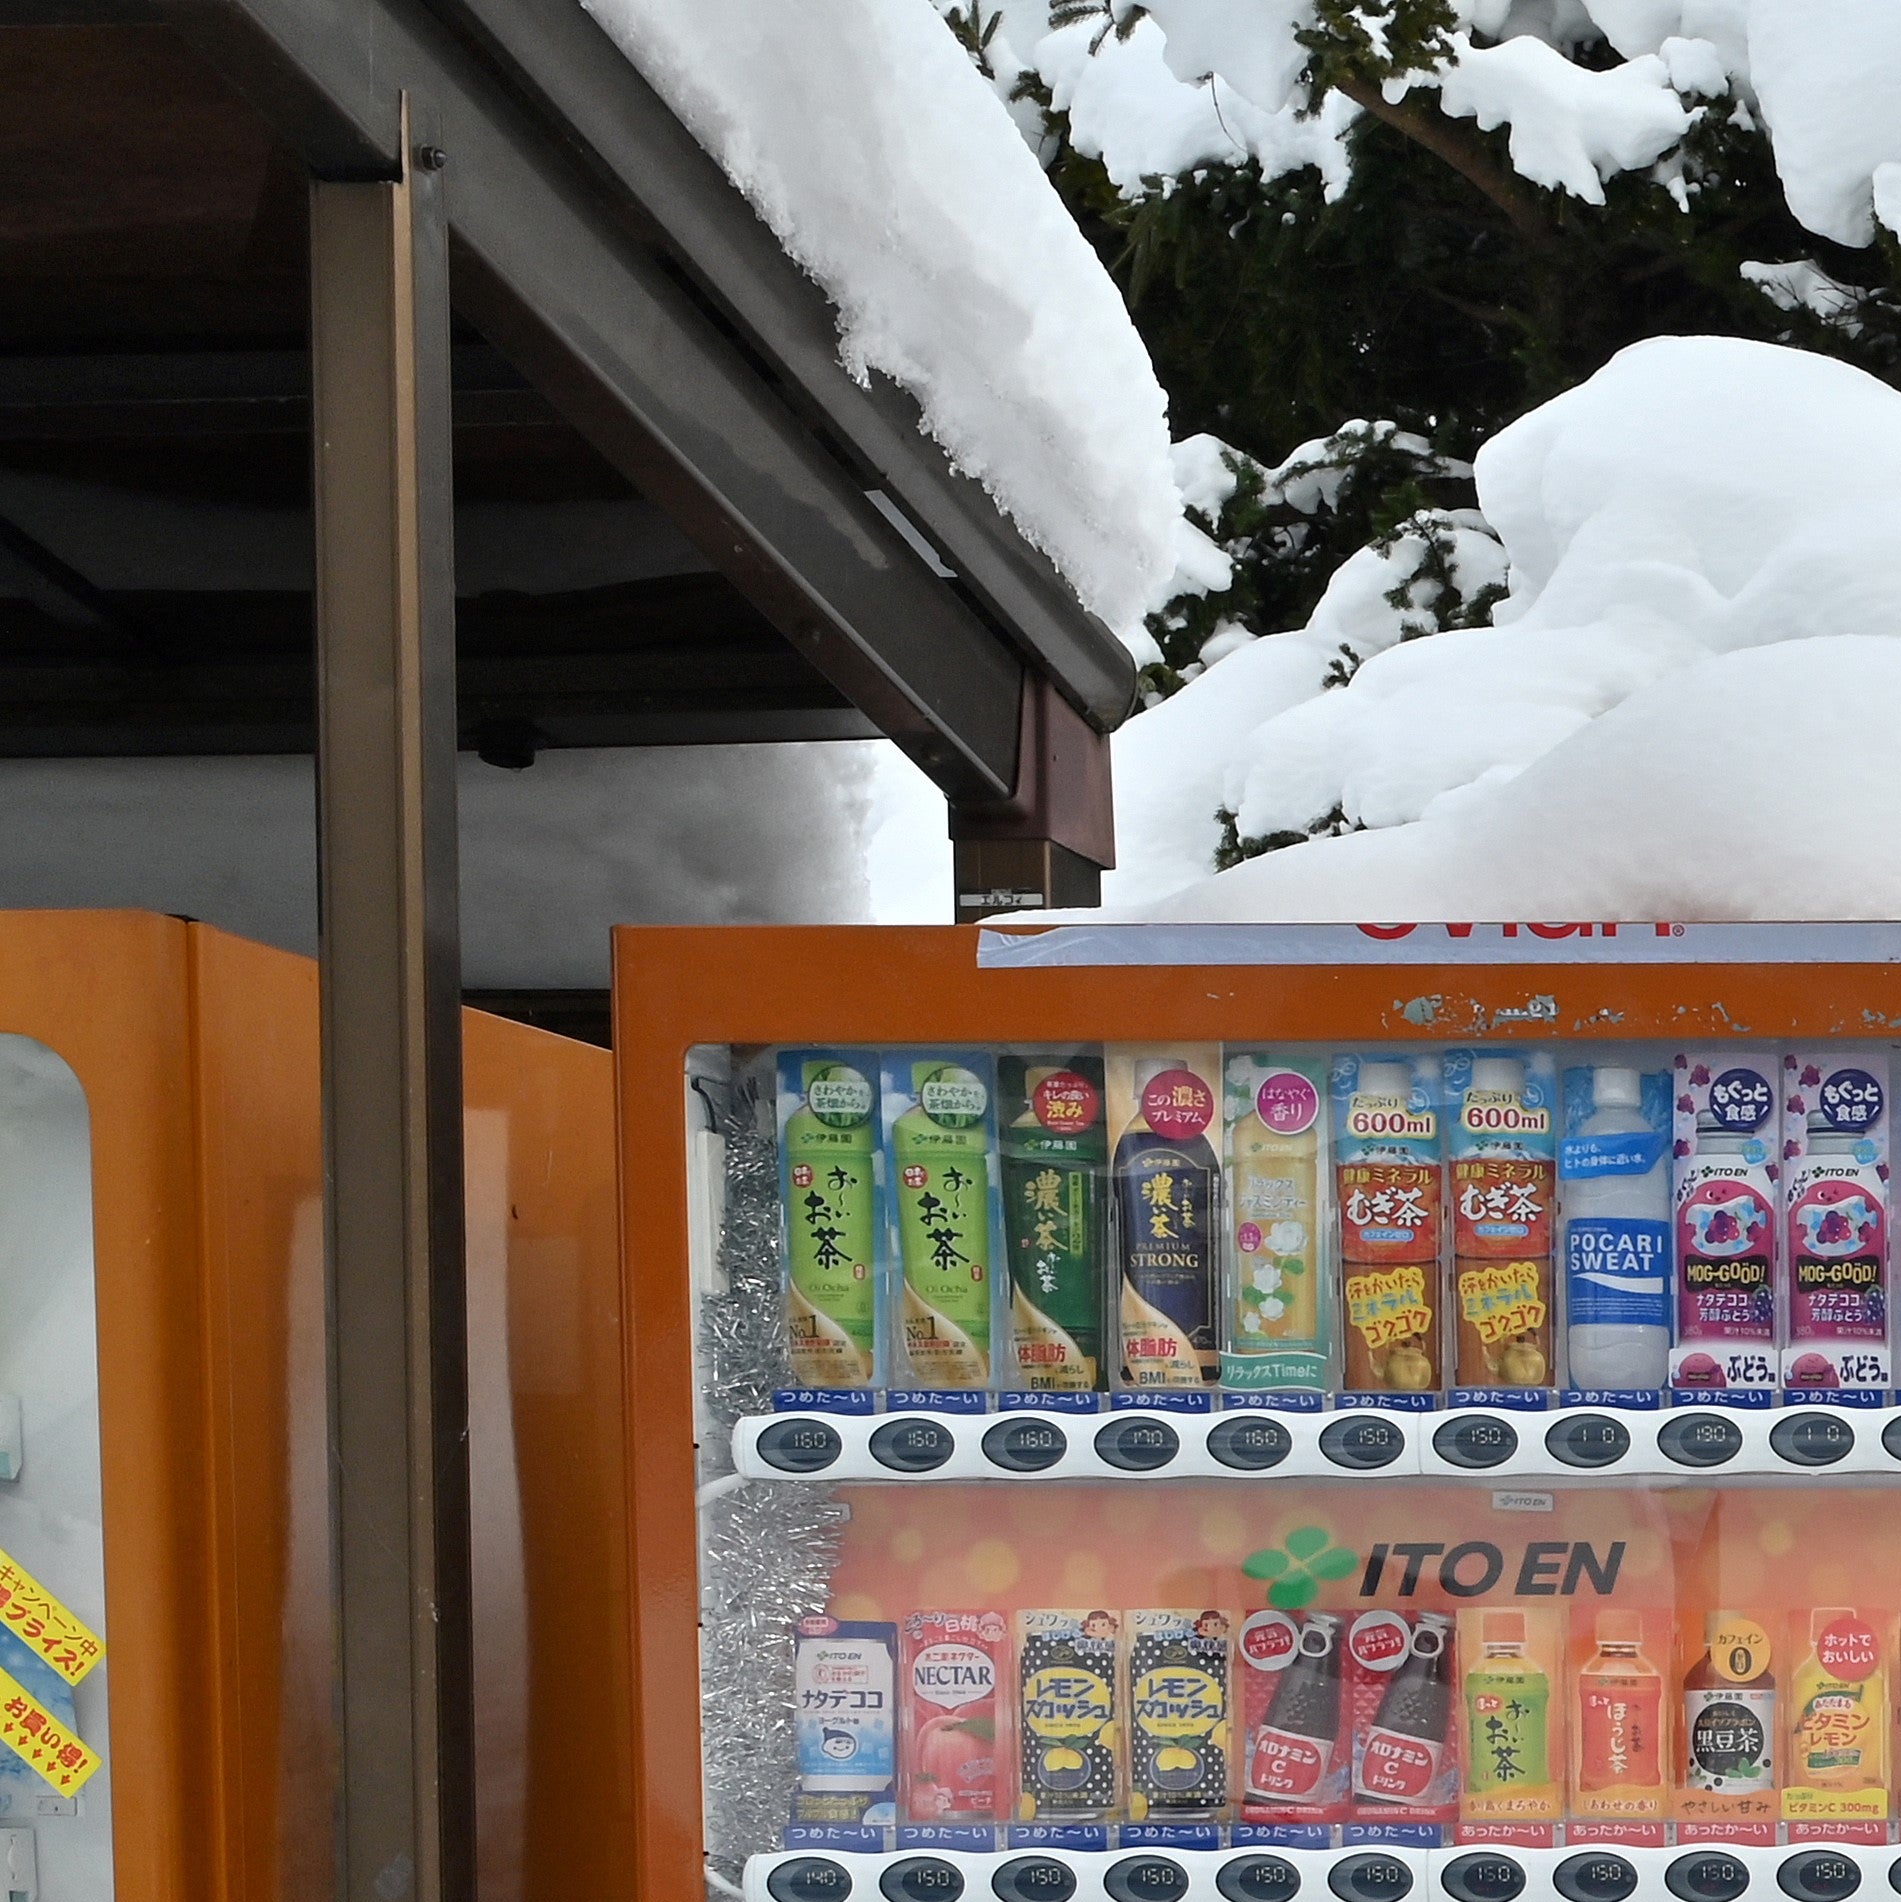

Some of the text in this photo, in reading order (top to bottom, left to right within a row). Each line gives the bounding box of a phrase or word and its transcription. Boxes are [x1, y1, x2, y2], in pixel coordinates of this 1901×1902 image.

[1148, 1086, 1206, 1107] この濃さ
[1262, 1087, 1310, 1102] はなやぐ
[1713, 1081, 1768, 1103] もぐっと
[1152, 1111, 1205, 1125] プレミアム
[1270, 1103, 1303, 1122] 香り
[1467, 1107, 1545, 1129] 600ml
[1725, 1103, 1756, 1122] 食感
[1353, 1113, 1431, 1134] 600ml
[1343, 1168, 1433, 1185] 健康ミネラル
[1346, 1188, 1429, 1227] むぎ茶
[1460, 1182, 1543, 1222] むぎ茶
[1570, 1233, 1663, 1253] POCARI
[1130, 1253, 1198, 1268] STRONG
[1570, 1252, 1654, 1272] SWEAT
[1360, 1540, 1626, 1598] ITO EN
[1718, 1634, 1763, 1646] カフェイン
[1824, 1634, 1872, 1647] ホットで
[1823, 1649, 1874, 1663] おいしい
[915, 1667, 992, 1686] NECTAR
[1036, 1678, 1095, 1699] レモン
[1149, 1678, 1208, 1699] レモン
[1026, 1700, 1109, 1720] スカッシュ
[1136, 1700, 1220, 1720] スカッシュ
[1696, 1727, 1759, 1753] 黒豆茶
[1681, 1801, 1772, 1814] やさしい甘み
[1789, 1802, 1880, 1815] ビタミンC 300mg
